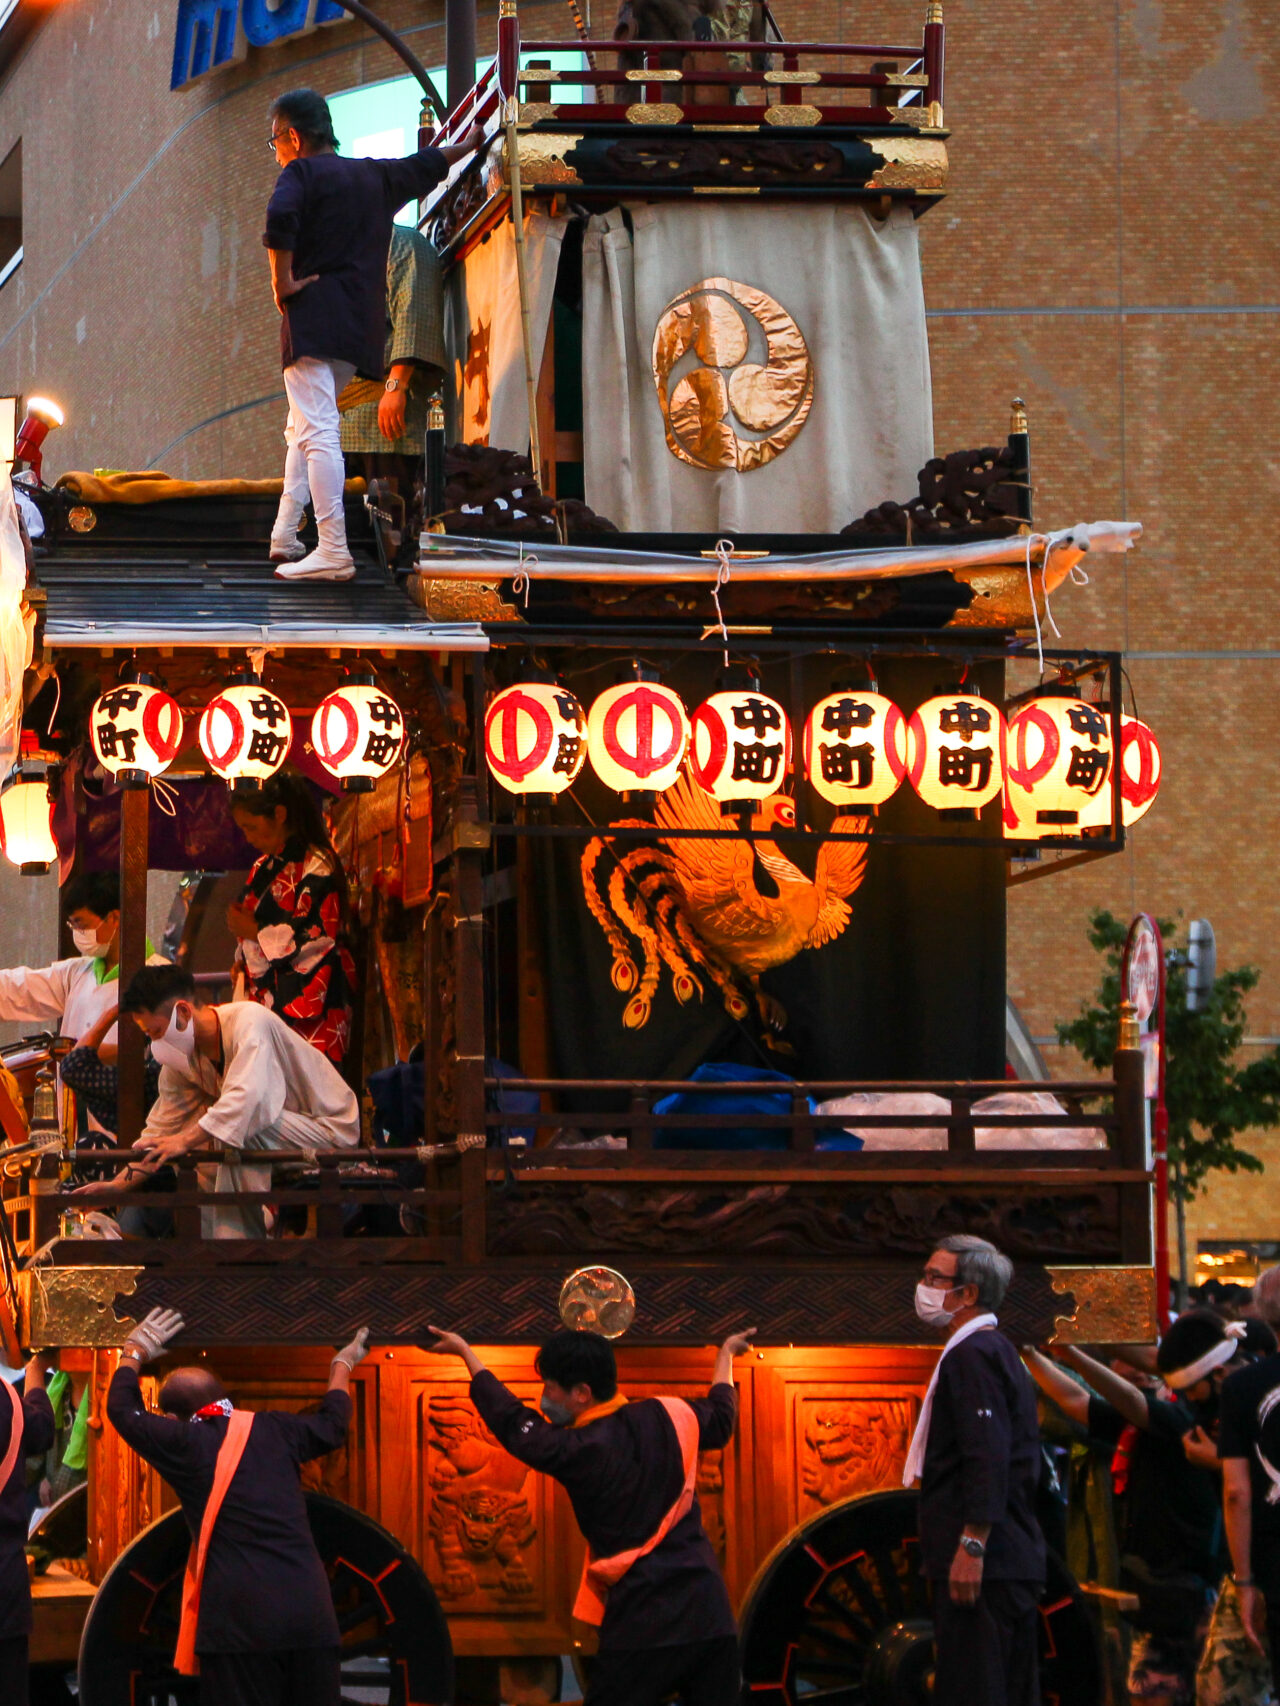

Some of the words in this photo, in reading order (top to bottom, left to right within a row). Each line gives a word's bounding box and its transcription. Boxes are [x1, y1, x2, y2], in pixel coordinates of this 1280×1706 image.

[97, 688, 142, 762] 中町
[247, 694, 289, 766] 中町
[363, 696, 401, 767] 中町
[730, 698, 784, 784] 中町
[819, 698, 876, 789] 中町
[938, 701, 994, 792] 中町
[1065, 704, 1111, 797] 中町
